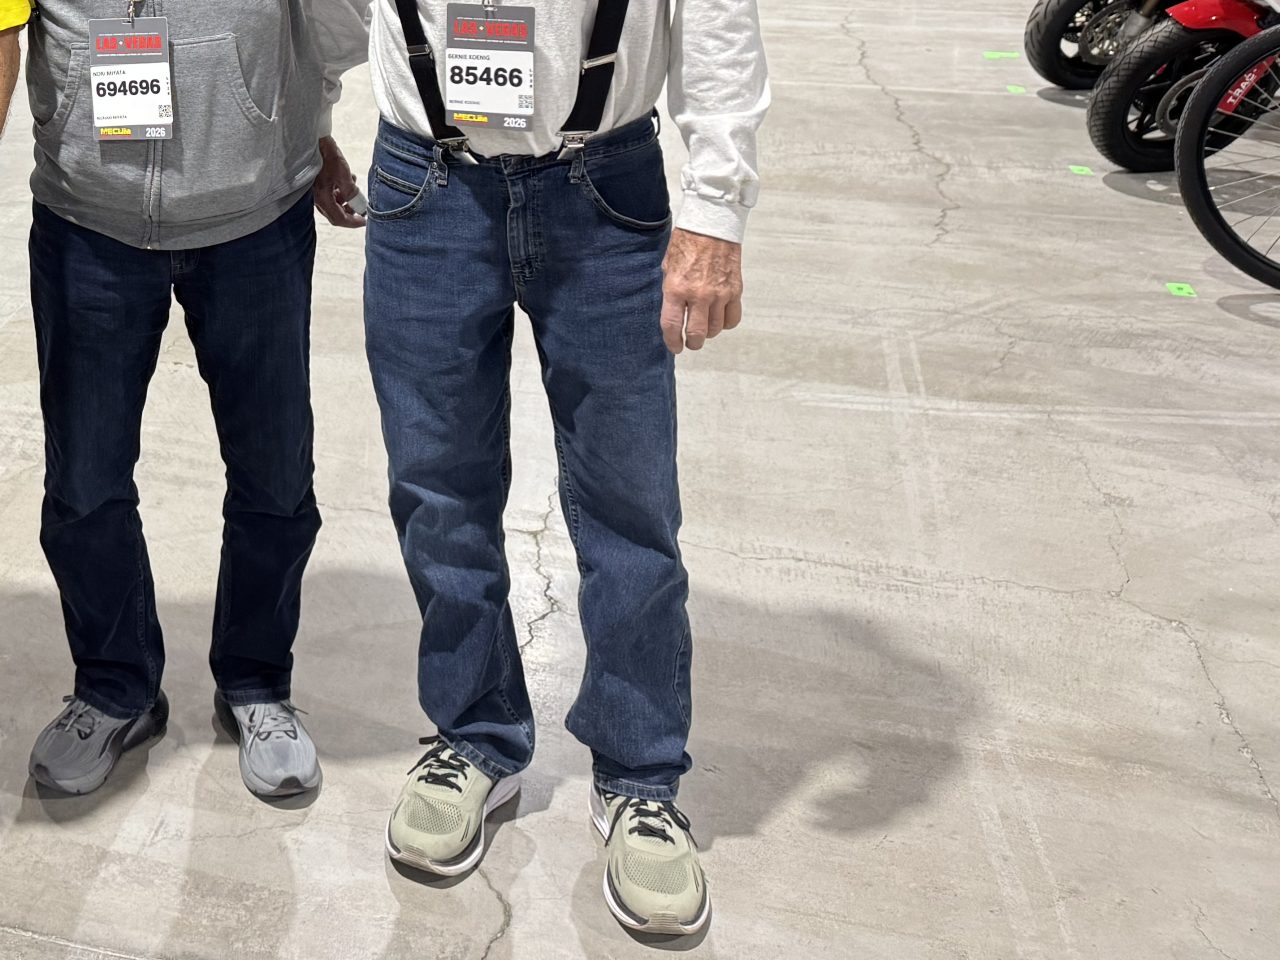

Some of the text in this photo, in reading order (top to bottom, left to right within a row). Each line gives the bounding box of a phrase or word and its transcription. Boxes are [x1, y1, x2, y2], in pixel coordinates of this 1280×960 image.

[453, 20, 478, 35] LAS
[450, 65, 523, 87] 85466
[95, 79, 161, 97] 694696
[453, 112, 527, 128] MECUM 2026
[100, 127, 166, 137] MECUM 2026
